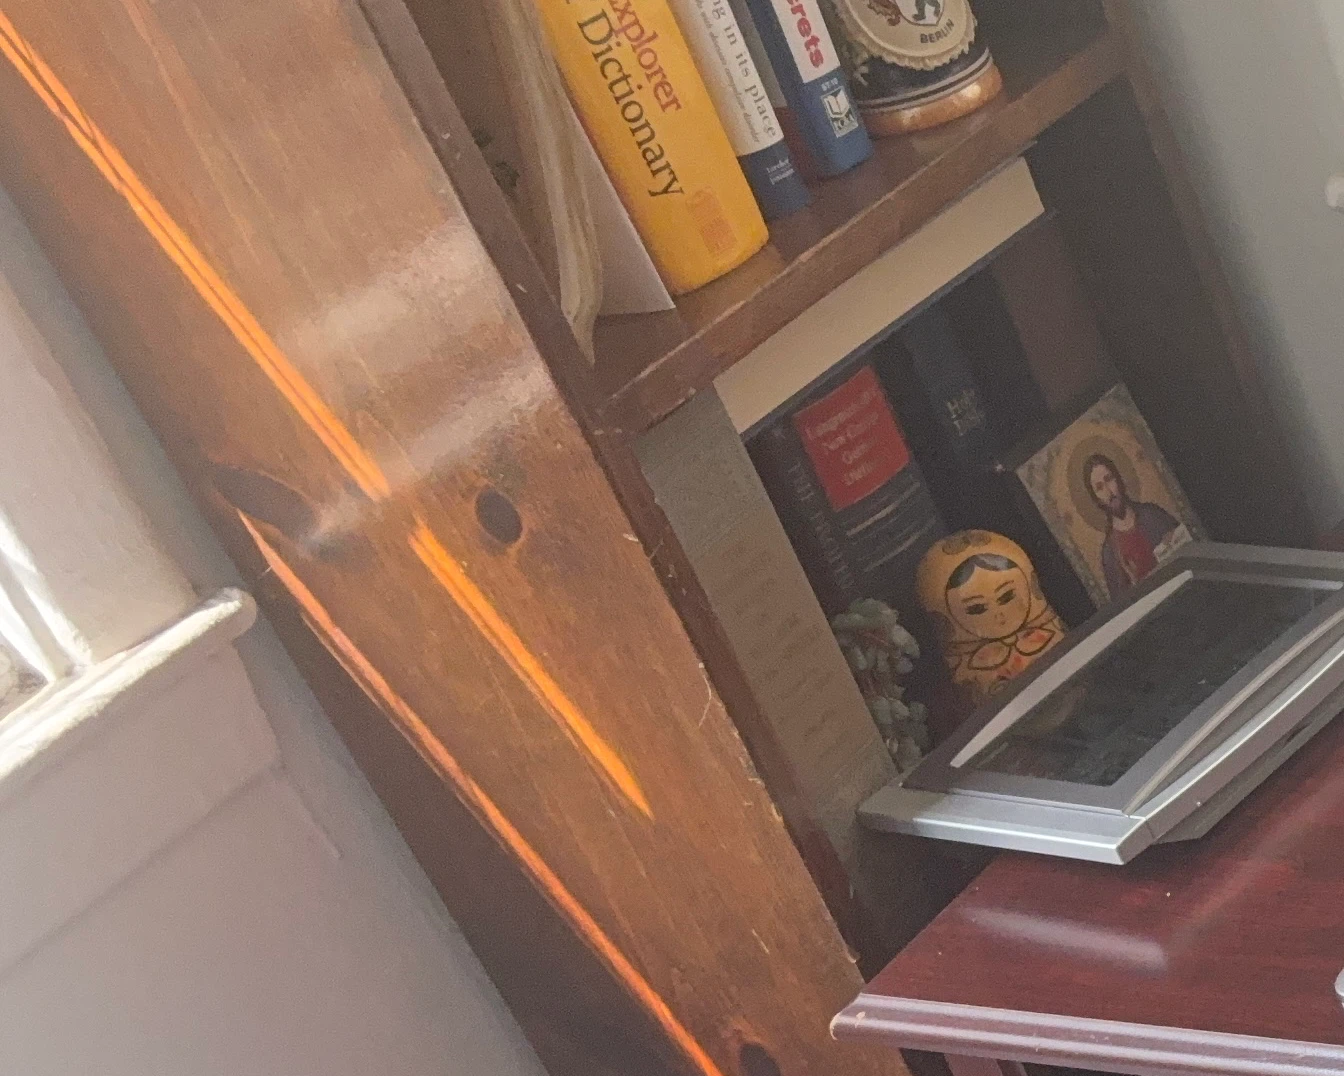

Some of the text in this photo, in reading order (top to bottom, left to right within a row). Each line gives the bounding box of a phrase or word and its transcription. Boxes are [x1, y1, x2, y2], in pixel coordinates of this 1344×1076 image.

[607, 0, 682, 112] xplorer
[723, 25, 777, 138] in its place
[788, 0, 823, 68] rets
[919, 19, 956, 45] BERLIN
[577, 9, 684, 197] Dictionary
